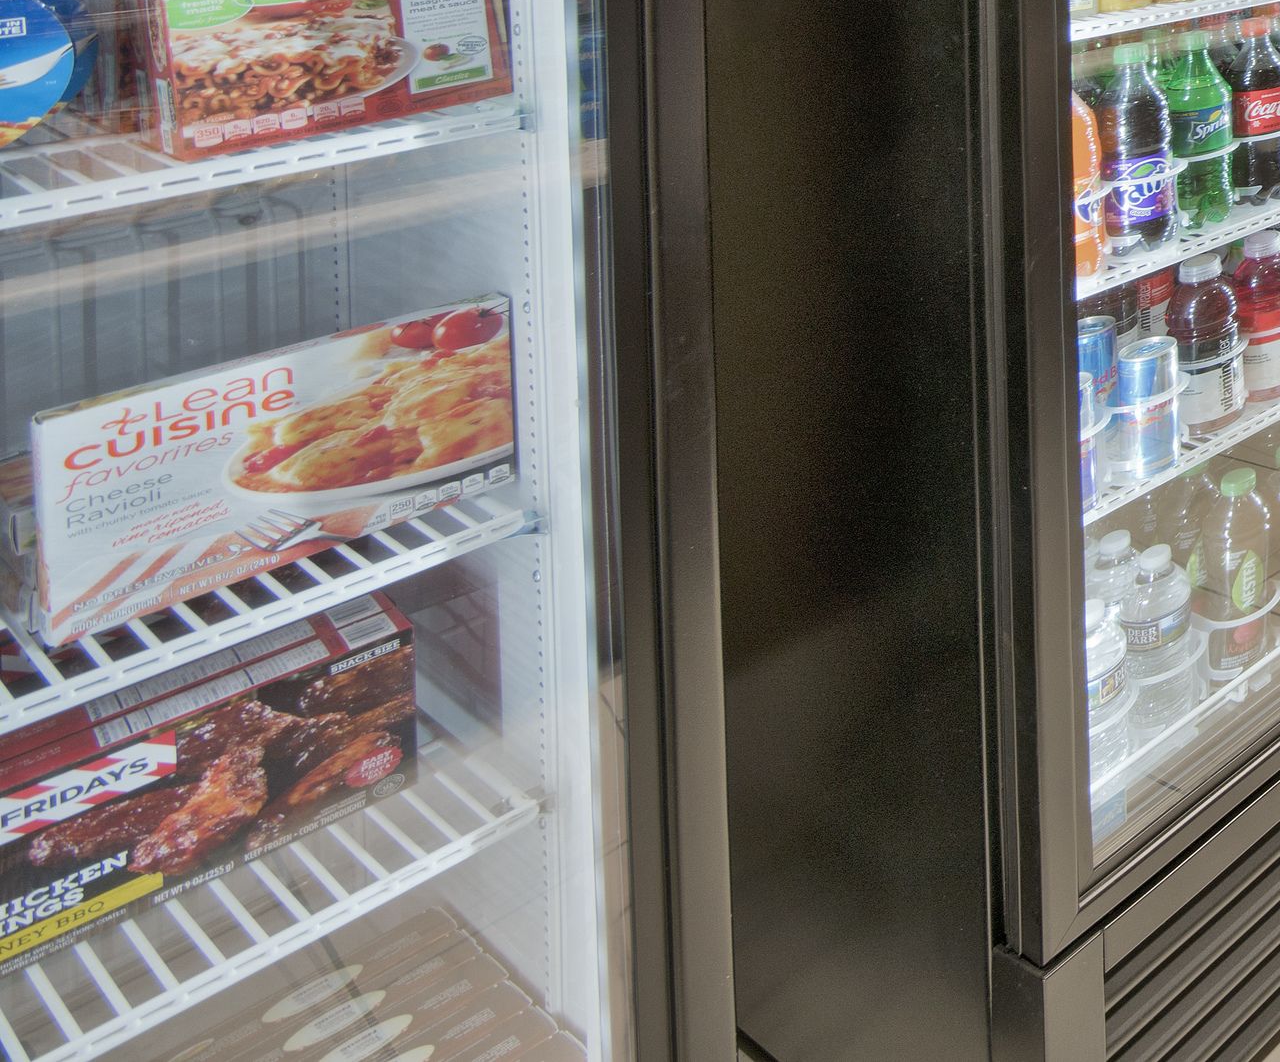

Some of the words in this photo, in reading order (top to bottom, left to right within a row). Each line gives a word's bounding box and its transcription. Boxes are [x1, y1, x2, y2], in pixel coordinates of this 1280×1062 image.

[409, 5, 436, 14] meat
[447, 0, 478, 8] sauce
[155, 366, 294, 420] Lean
[56, 432, 232, 505] favorites
[64, 472, 174, 513] Cheese
[65, 489, 162, 529] Ravioli
[139, 499, 179, 515] tomato
[182, 489, 213, 501] sauce
[1242, 557, 1257, 608] NESTEA
[1127, 633, 1158, 645] PARK
[1128, 626, 1156, 636] DEER
[330, 649, 371, 675] SNACK
[375, 639, 400, 656] SIZE
[1, 756, 150, 828] FRIDAYS
[244, 847, 263, 862] KEEP
[264, 833, 292, 852] FROZEN
[299, 820, 319, 835] COOK
[321, 799, 366, 827] THOROUGHLY
[55, 900, 105, 928] BBQ
[154, 891, 169, 904] NET
[170, 886, 183, 897] WT
